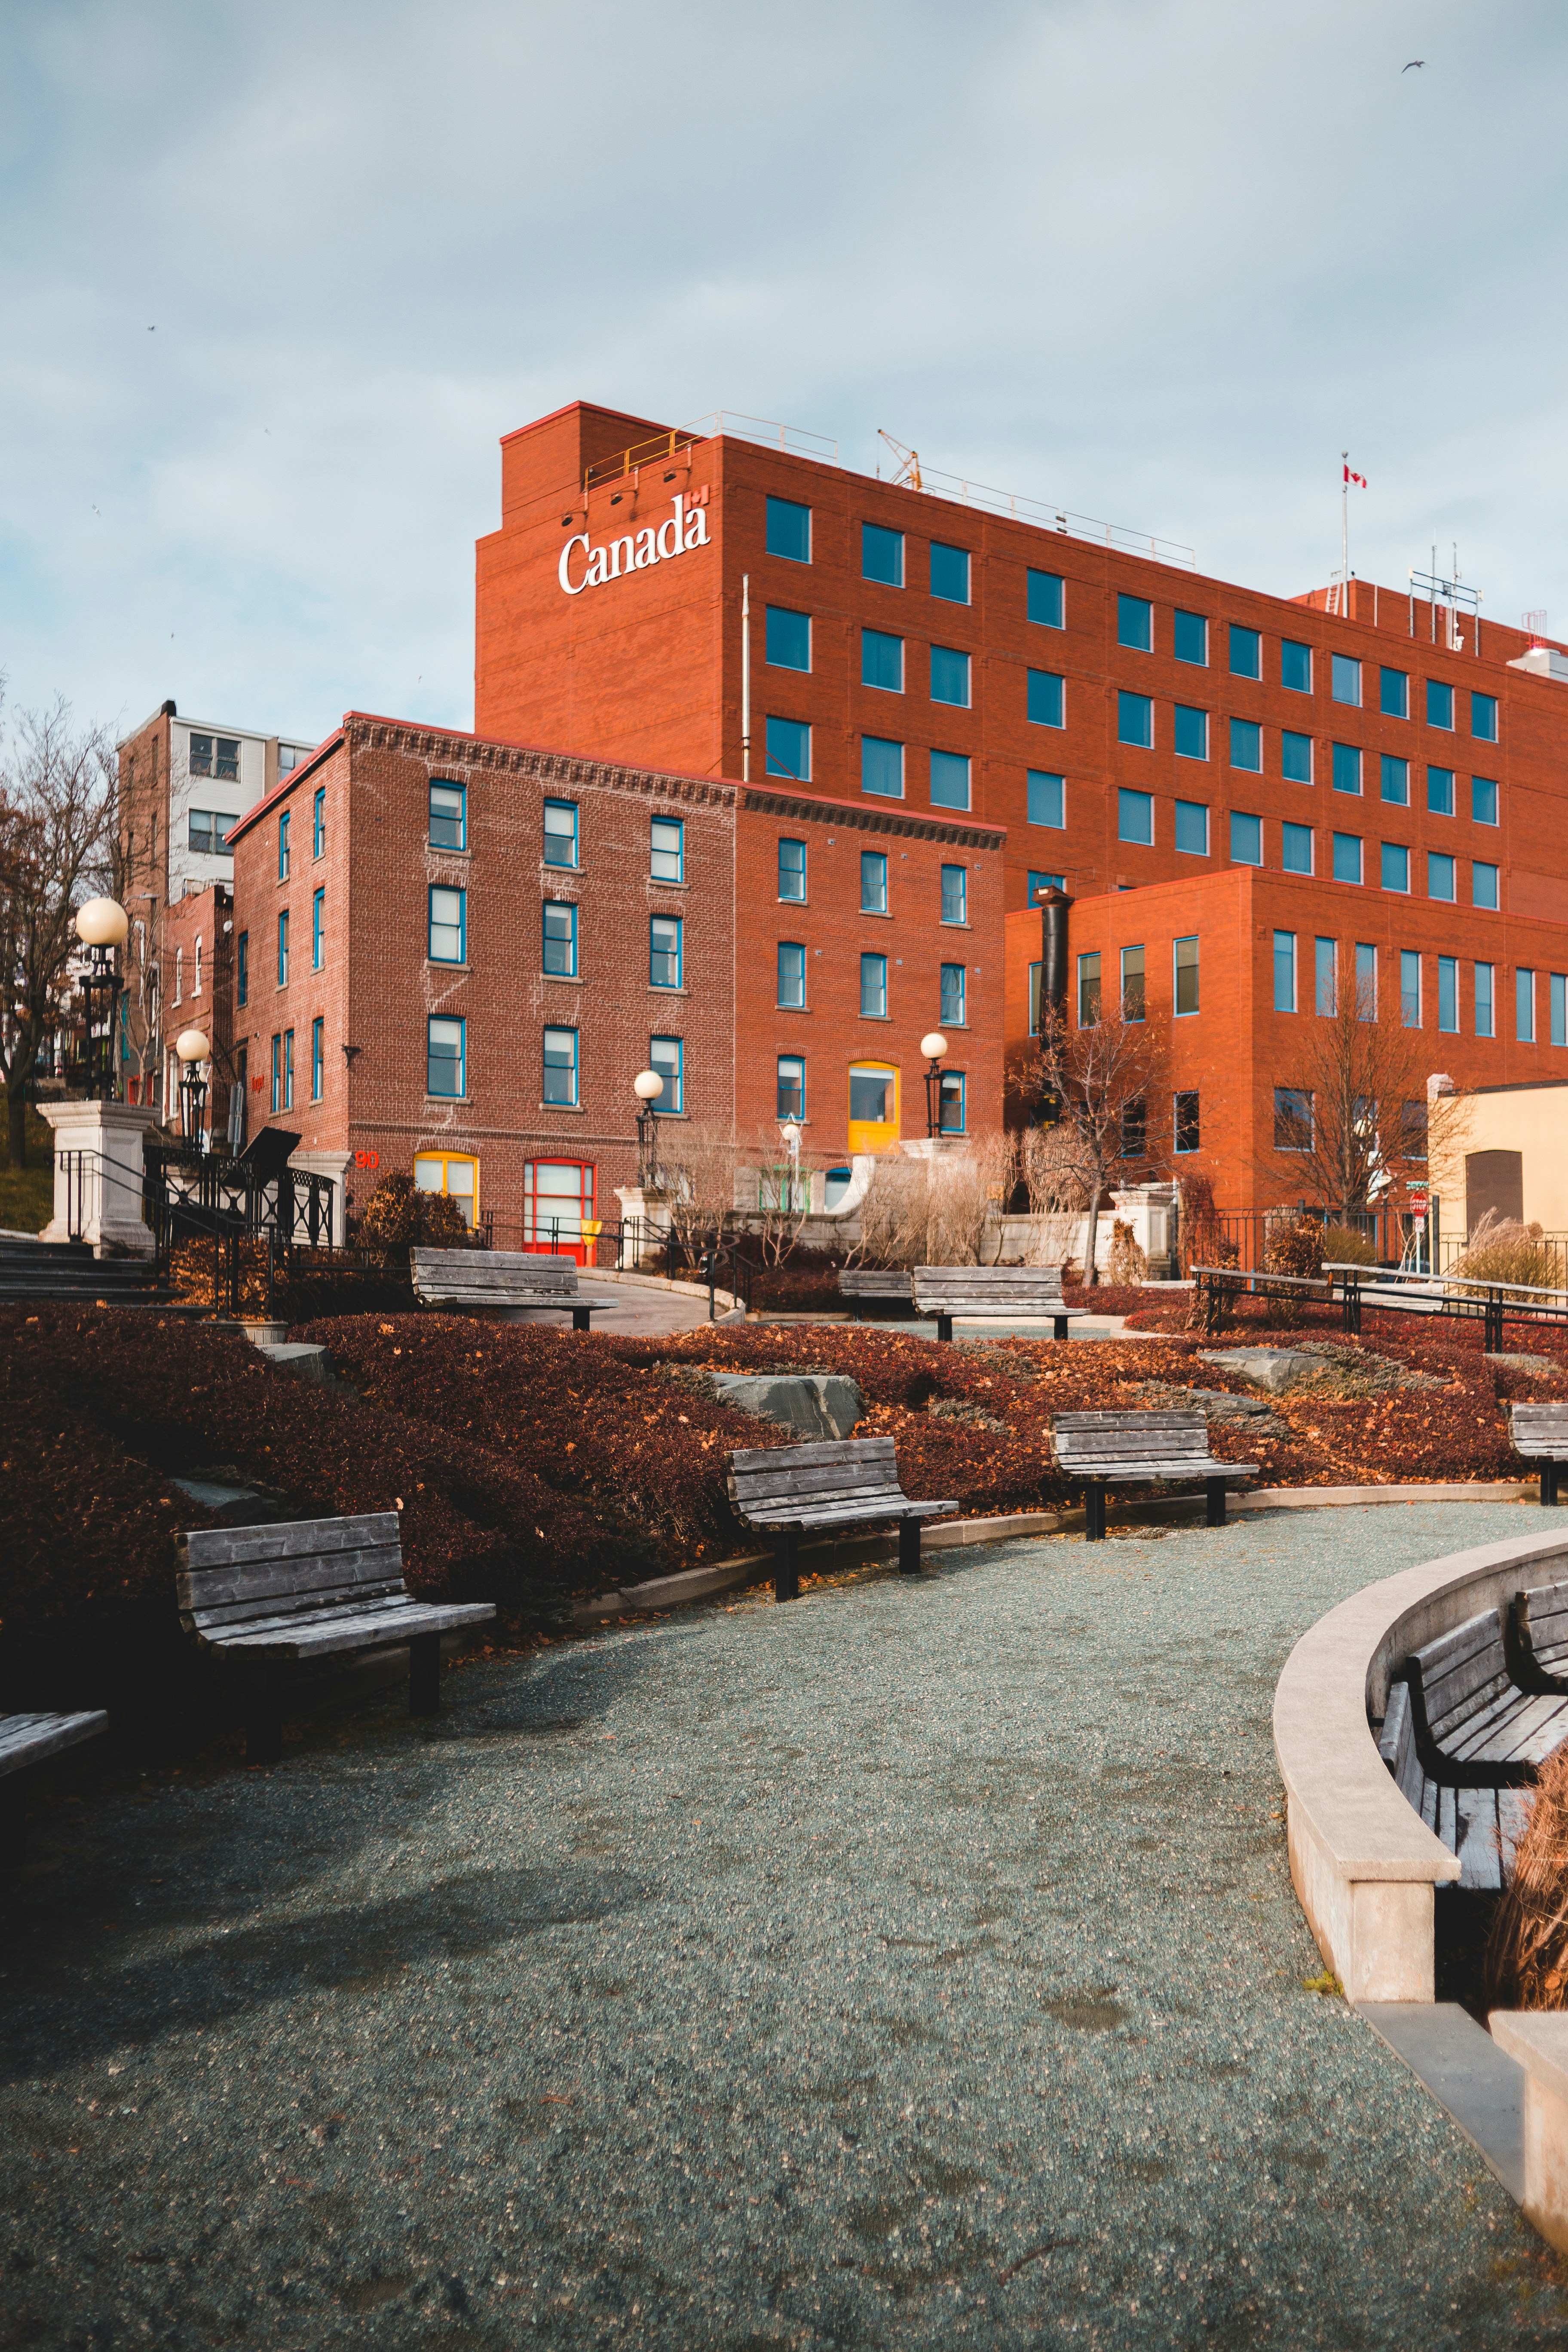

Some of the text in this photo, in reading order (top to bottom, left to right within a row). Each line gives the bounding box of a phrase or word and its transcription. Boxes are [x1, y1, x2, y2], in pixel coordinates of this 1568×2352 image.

[558, 493, 711, 594] Canada
[355, 1150, 379, 1169] 90
[1411, 1199, 1427, 1210] STOP
